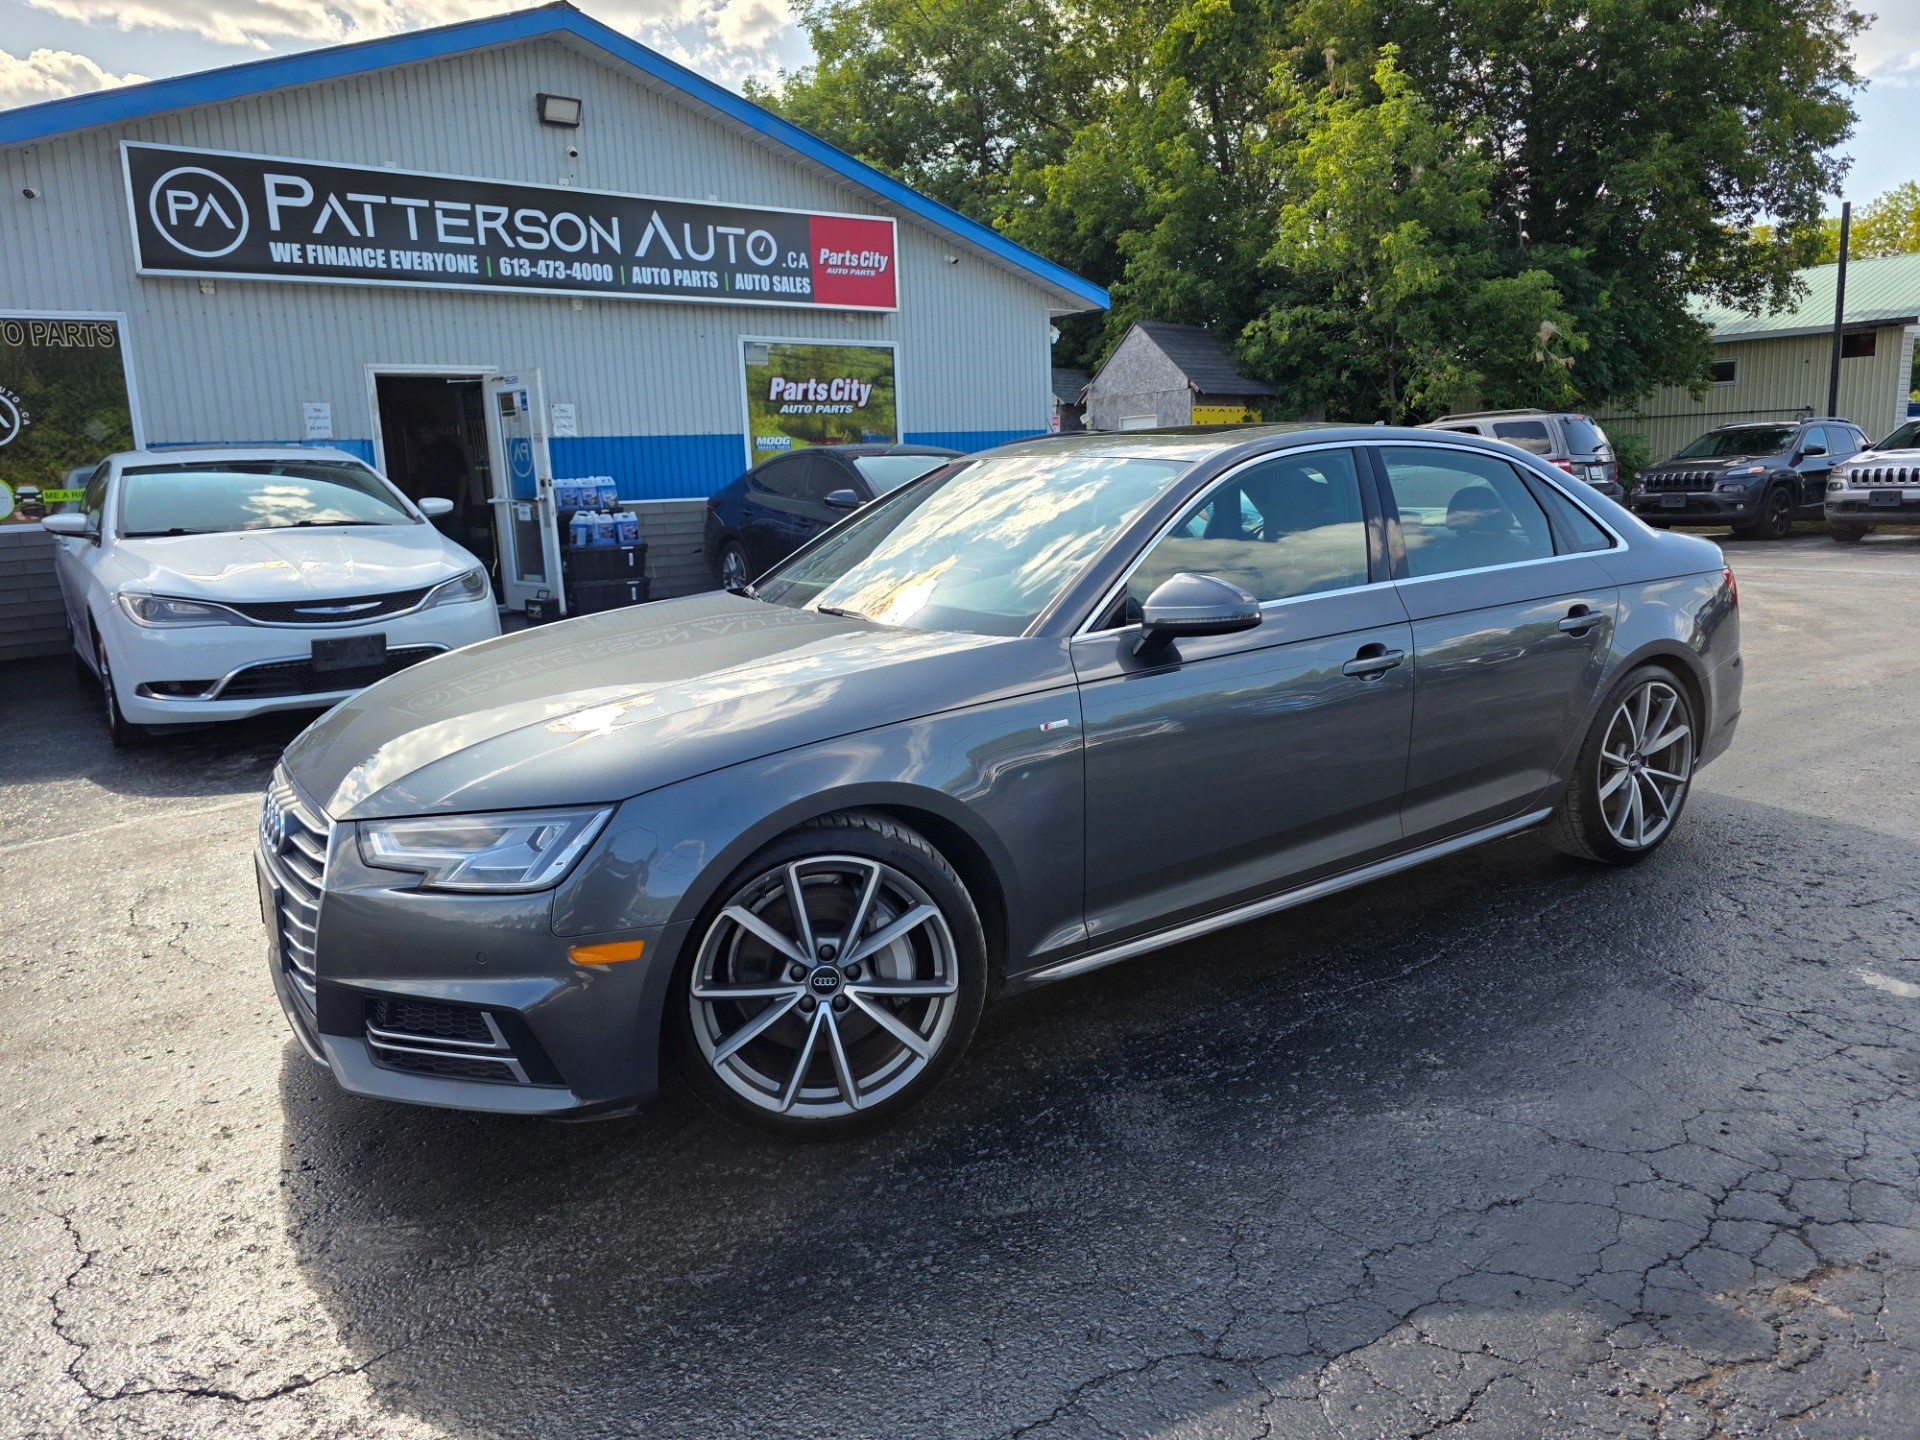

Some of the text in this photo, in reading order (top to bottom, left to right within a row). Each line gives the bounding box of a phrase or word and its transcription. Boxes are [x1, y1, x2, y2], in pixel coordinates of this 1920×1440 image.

[166, 189, 236, 230] PA
[263, 173, 622, 255] PATTERSON
[635, 209, 778, 267] AUTO
[269, 241, 479, 275] WE FINANCE EVERYONE
[499, 258, 614, 283] 613-473-4000
[632, 265, 719, 289] AUTO PARTS
[826, 267, 876, 277] AUTO PARTS
[735, 273, 811, 294] AUTO SALES
[0, 320, 115, 348] O PARTS
[780, 404, 853, 414] AUTO PARTS
[756, 436, 791, 445] MOOG
[45, 491, 60, 500] ME
[62, 491, 69, 499] A
